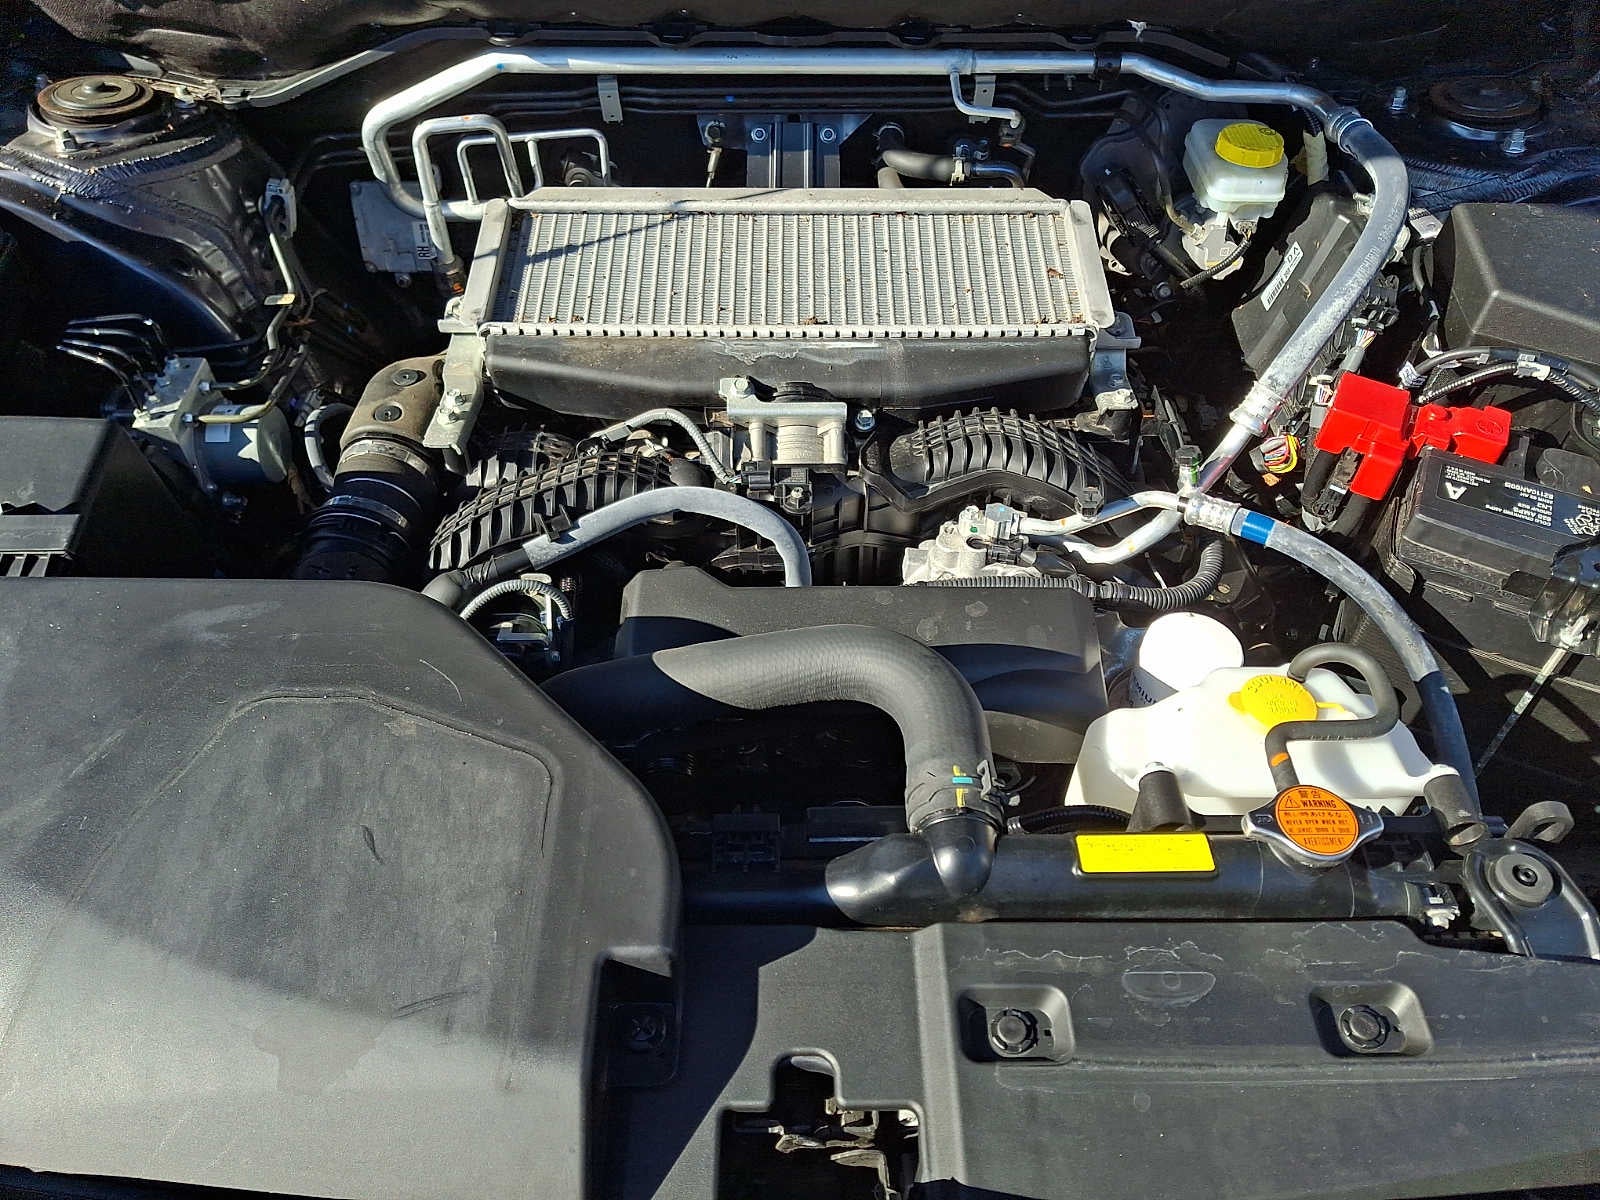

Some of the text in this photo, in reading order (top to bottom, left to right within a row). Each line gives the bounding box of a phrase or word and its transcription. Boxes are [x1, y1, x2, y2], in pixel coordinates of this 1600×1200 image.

[416, 246, 431, 257] RH
[1445, 481, 1467, 500] A
[1485, 504, 1502, 512] AMPS
[1503, 509, 1534, 522] CRANKING
[1301, 799, 1337, 809] WARNING
